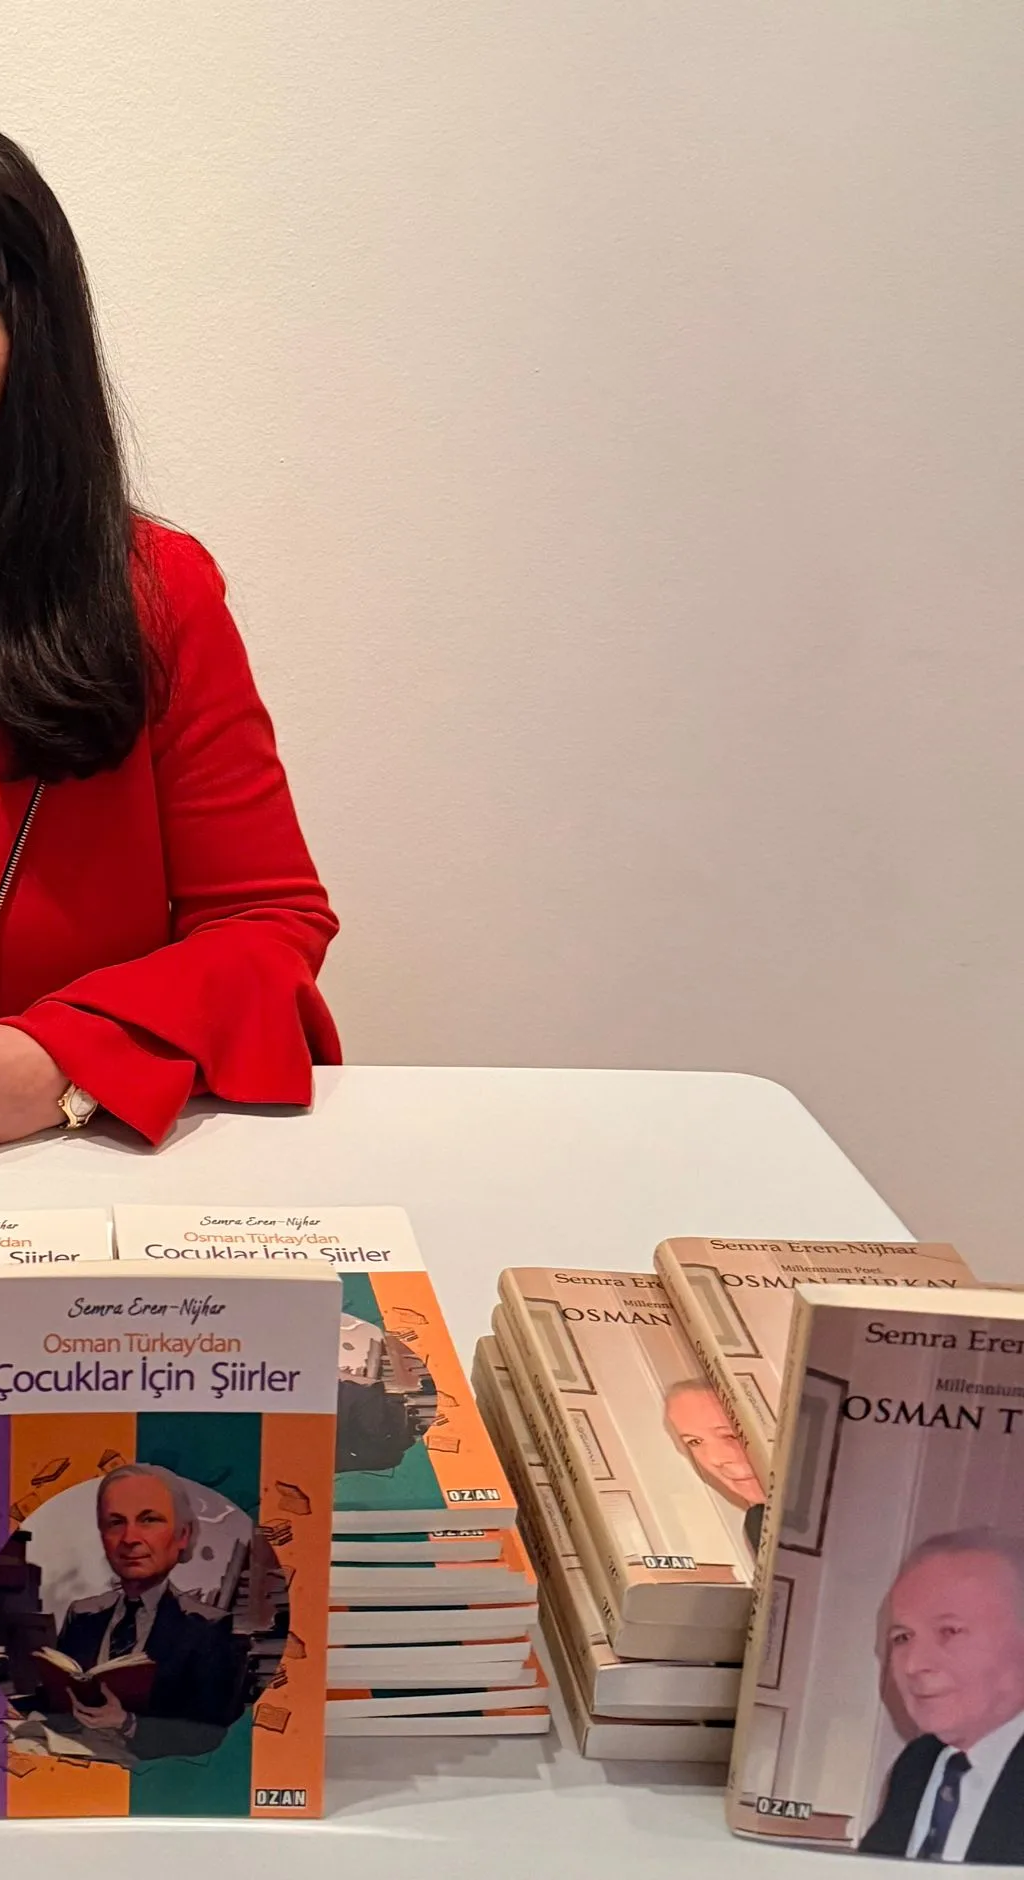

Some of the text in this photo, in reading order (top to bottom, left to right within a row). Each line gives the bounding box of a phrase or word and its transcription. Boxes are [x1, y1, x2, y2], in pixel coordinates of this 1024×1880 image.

[199, 1216, 321, 1230] Semra Eren-Nijhar
[183, 1231, 340, 1246] Osman Türkay'dan
[320, 1247, 391, 1266] Şiirler
[710, 1239, 918, 1258] Semra Eren-Nijhar
[554, 1273, 626, 1288] Semra
[68, 1295, 226, 1325] Semra Eren-Nijhar
[562, 1307, 672, 1327] OSMAN
[42, 1332, 242, 1358] Osman Türkay'dan
[865, 1322, 957, 1349] Semra
[140, 1356, 195, 1398] İçin
[210, 1361, 301, 1399] Şiirler
[842, 1395, 985, 1431] OSMAN
[446, 1489, 501, 1501] OZAN
[642, 1555, 697, 1569] OZAN
[255, 1789, 306, 1806] OZAN
[756, 1796, 812, 1820] OZAN
